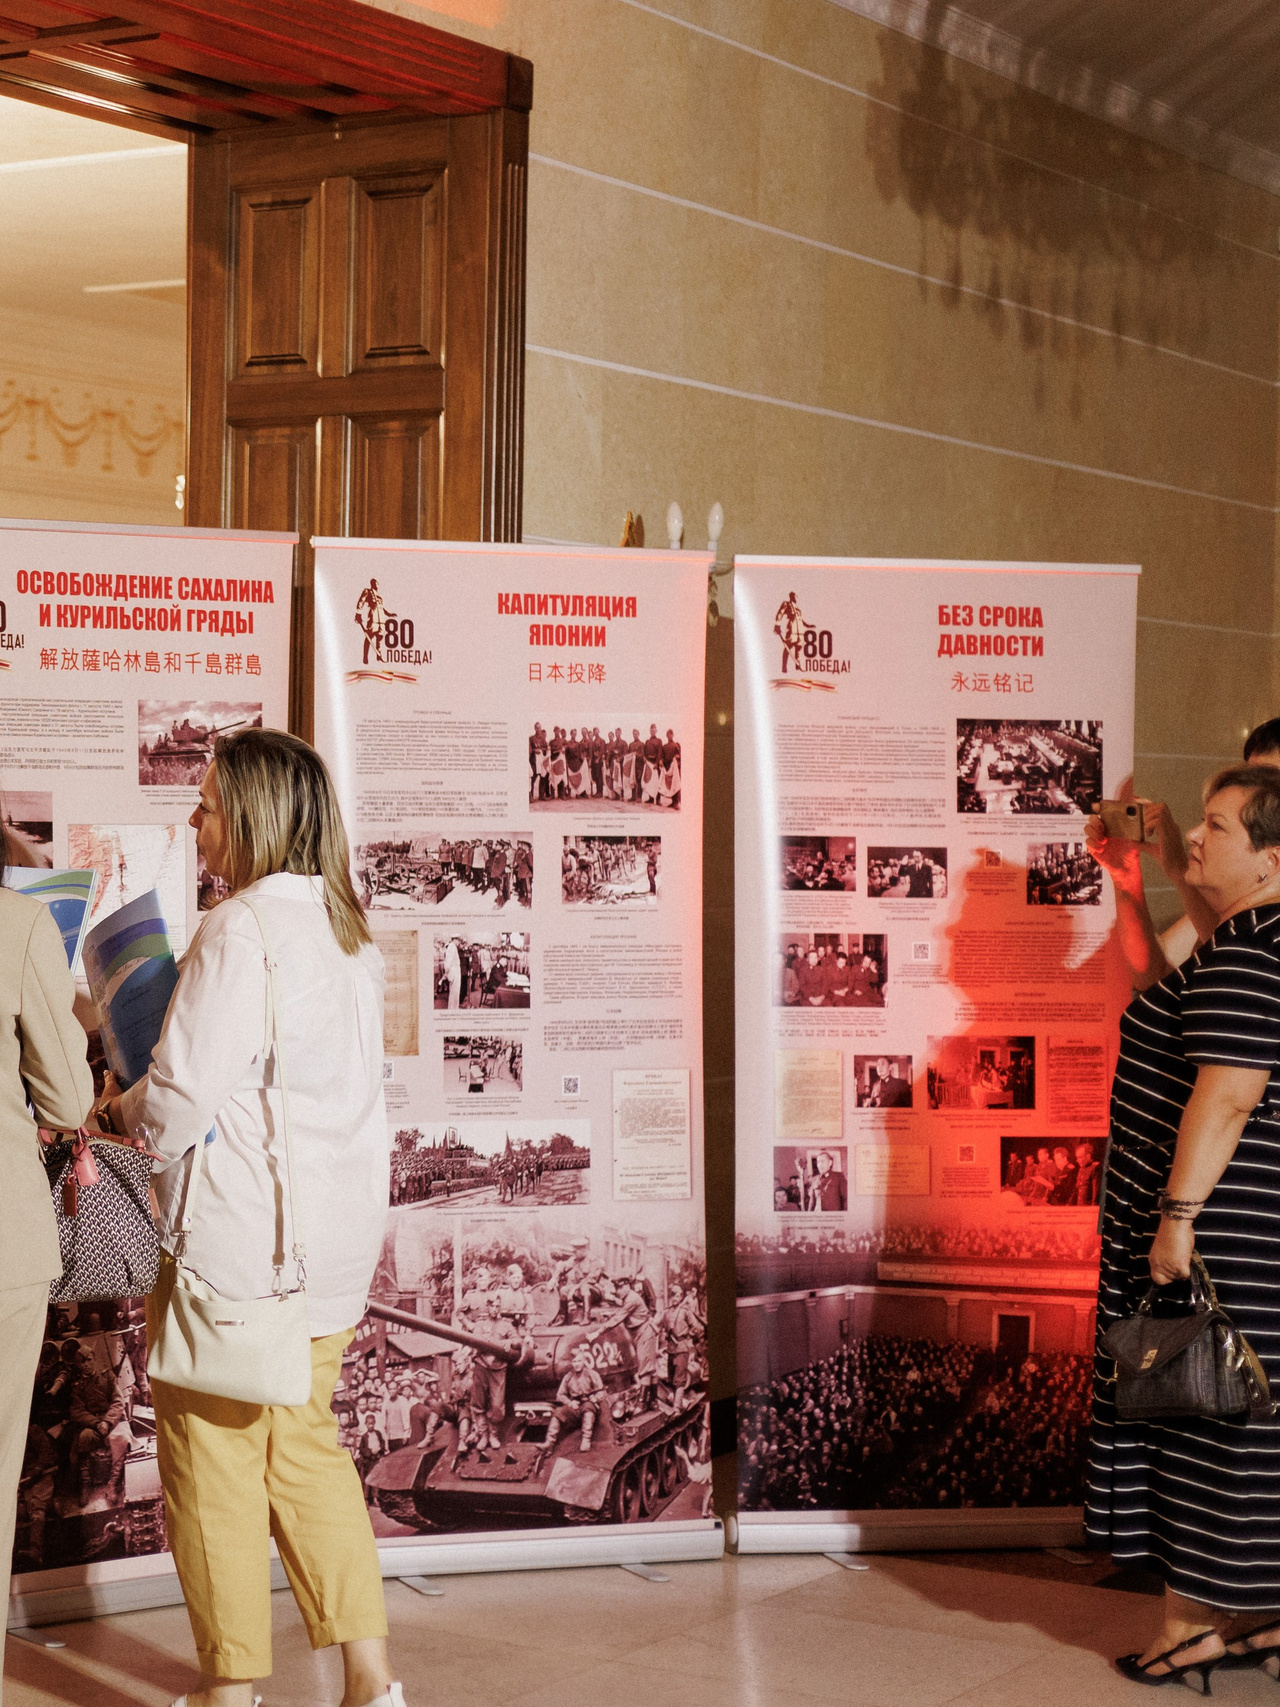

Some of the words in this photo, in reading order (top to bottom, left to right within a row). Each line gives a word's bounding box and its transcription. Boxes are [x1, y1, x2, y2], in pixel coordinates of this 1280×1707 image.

[17, 570, 172, 601] ОСВОБОЖДЕНИЕ
[178, 577, 274, 603] САХАЛИНА
[498, 593, 636, 620] КАПИТУЛЯЦИЯ
[939, 605, 973, 626] БЕЗ
[979, 606, 1043, 628] СРОКА
[40, 604, 51, 627] И
[57, 605, 181, 631] КУРИЛЬСКОЙ
[187, 609, 253, 637] ГРЯДЫ
[384, 618, 414, 649] 80
[530, 624, 605, 647] ЯПОНИИ
[804, 630, 832, 657] 80
[386, 649, 432, 665] ПОБЕДА!
[938, 634, 1043, 657] ДАВНОСТИ
[40, 648, 261, 676] 解放薩哈林島和千島群島
[529, 662, 606, 683] 日本投降
[805, 659, 851, 674] ПОБЕДА!
[951, 671, 1034, 693] 永远铭记
